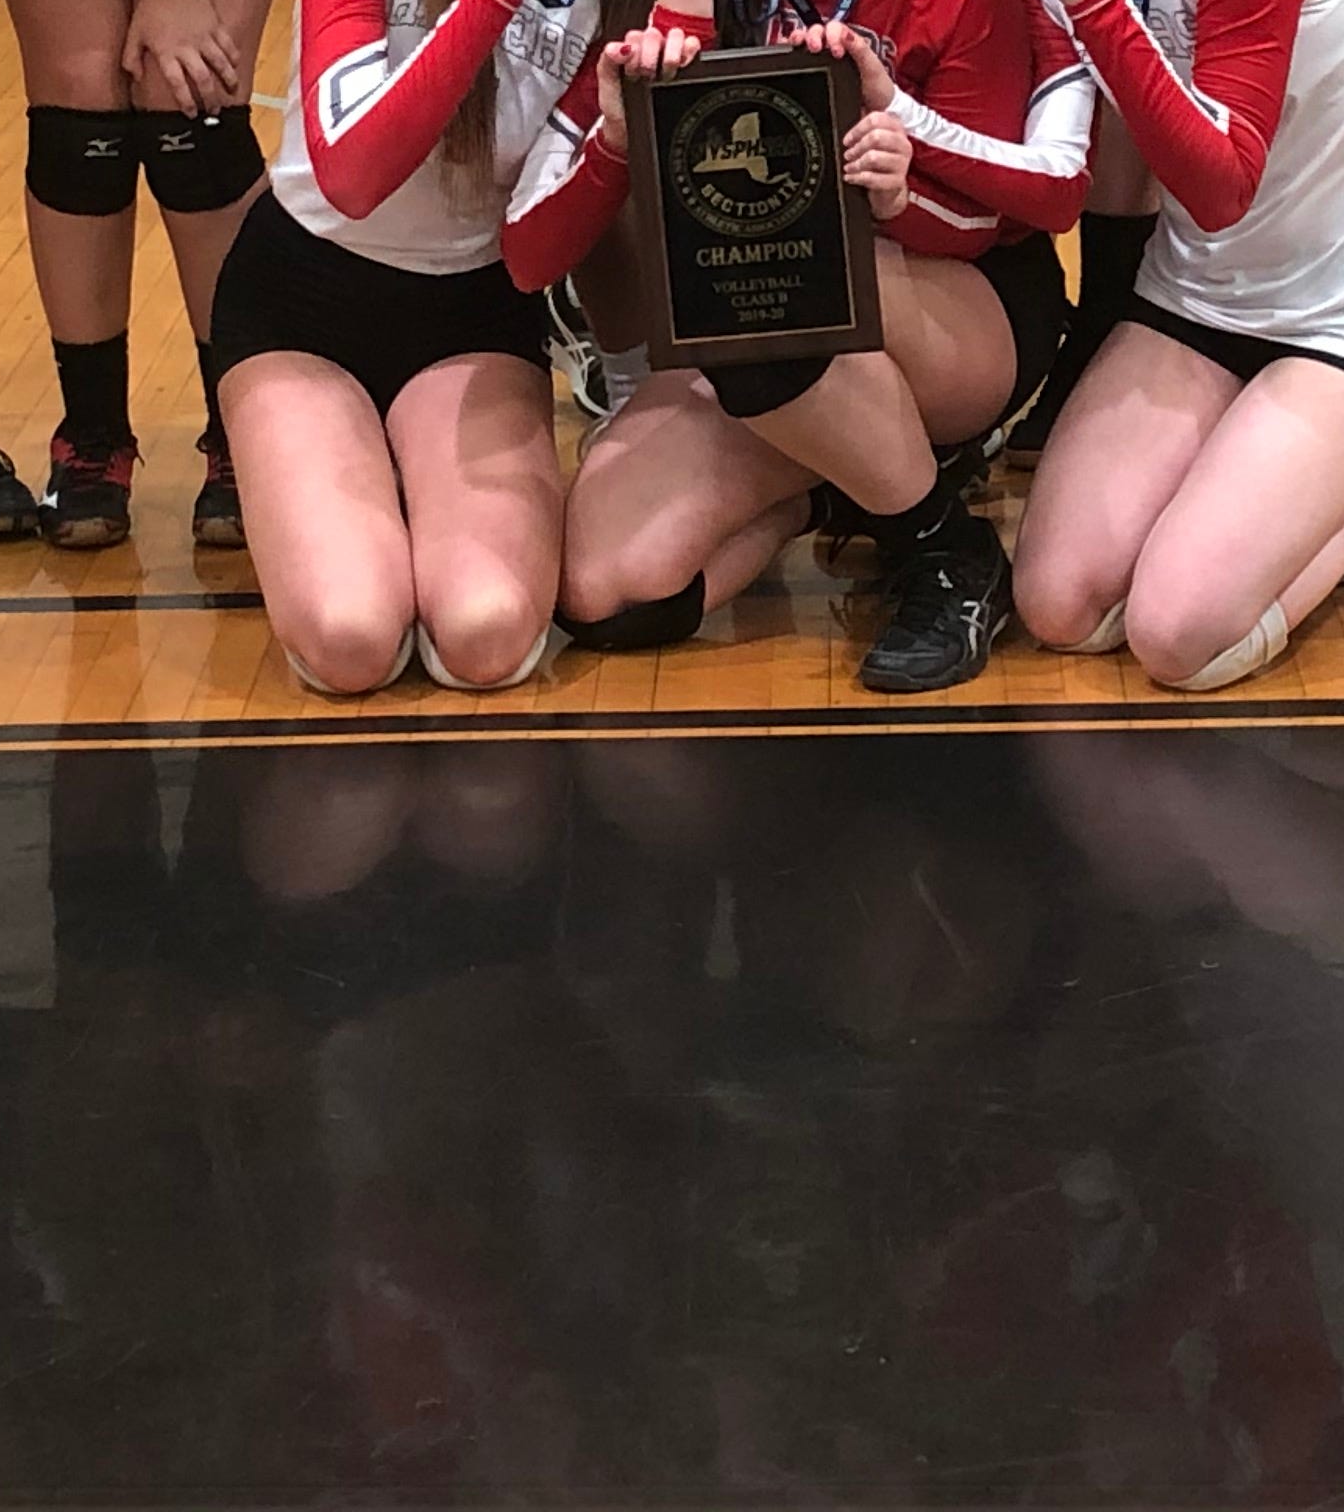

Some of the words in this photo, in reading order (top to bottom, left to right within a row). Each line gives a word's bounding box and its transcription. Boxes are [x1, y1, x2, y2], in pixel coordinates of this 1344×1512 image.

[701, 183, 781, 217] SECTION
[778, 178, 801, 201] IX
[696, 239, 814, 268] CHAMPION
[712, 275, 804, 294] VOLLEYBALL
[731, 292, 774, 308] CLASS
